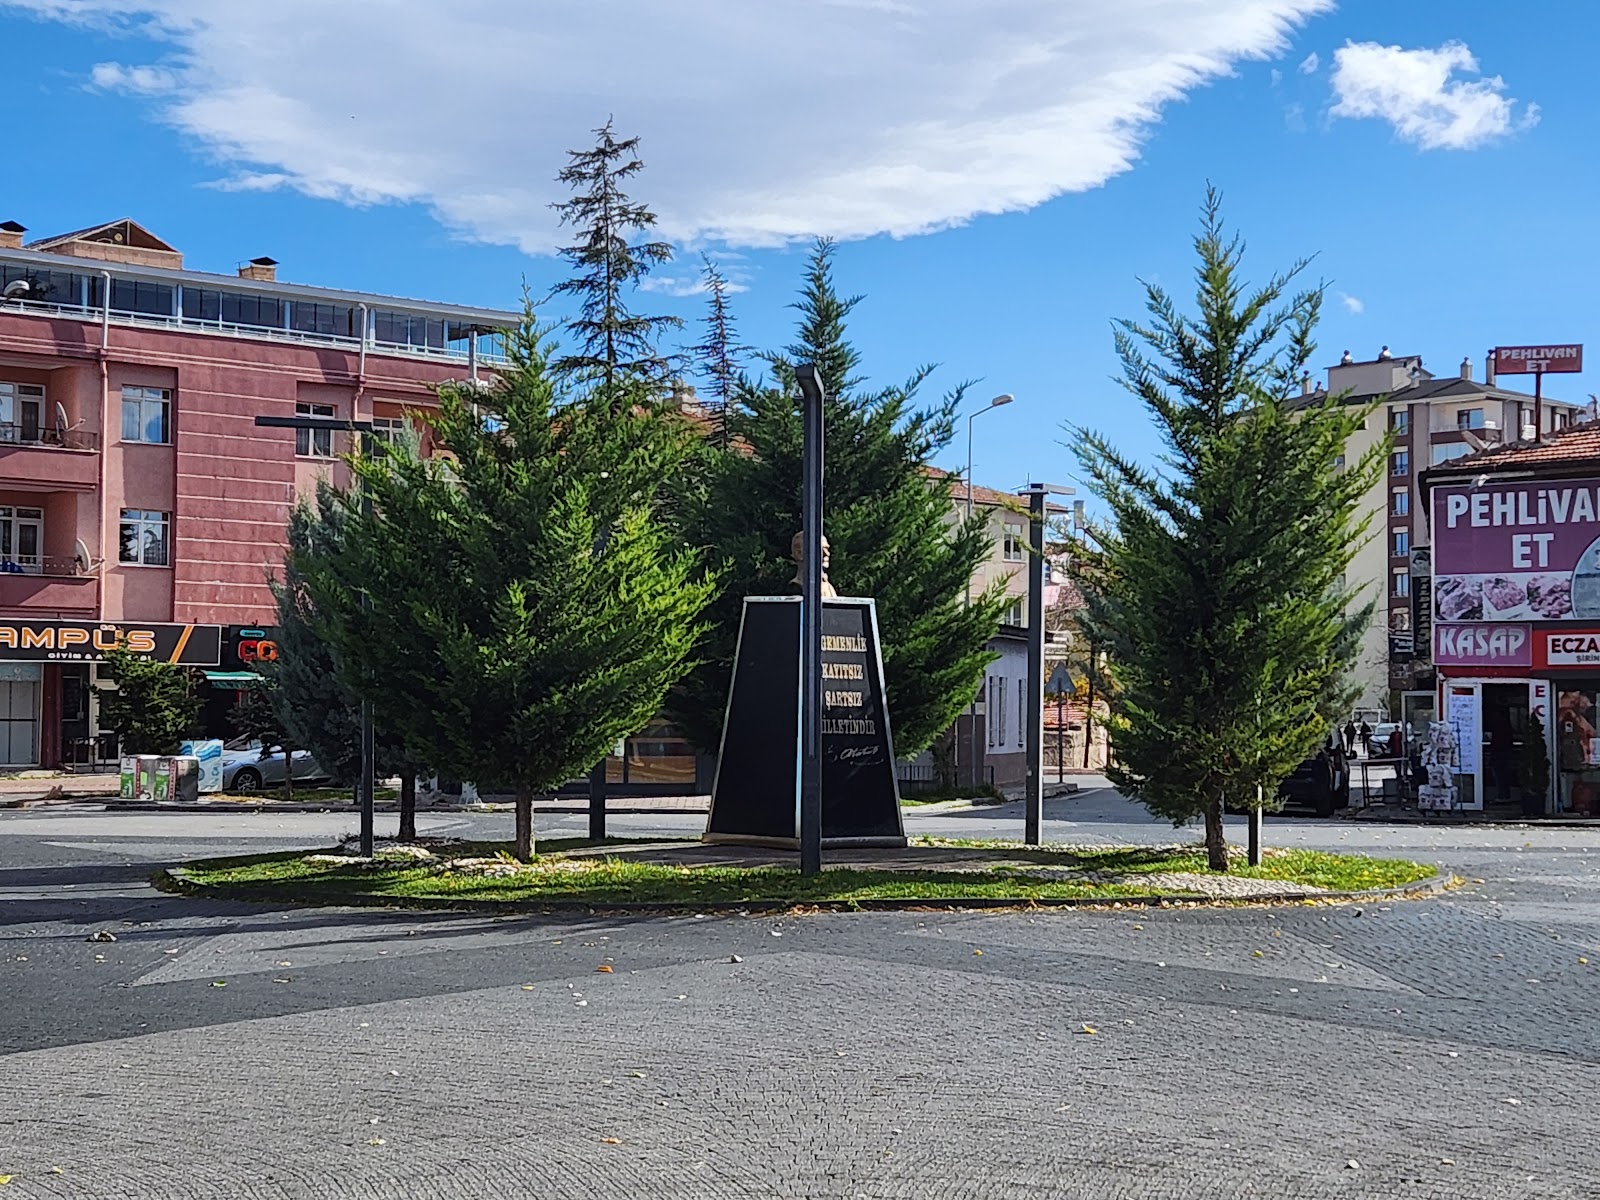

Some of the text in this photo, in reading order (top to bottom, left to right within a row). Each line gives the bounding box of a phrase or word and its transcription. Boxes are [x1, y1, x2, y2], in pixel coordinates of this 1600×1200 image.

[1526, 360, 1551, 372] ET
[1512, 533, 1554, 568] ET
[821, 633, 867, 652] GEMENLİK
[1439, 627, 1526, 659] KASAP
[821, 663, 864, 680] KAYITSIZ
[825, 690, 863, 711] ŞARTSIZ
[821, 714, 876, 735] İLLETİNDİR
